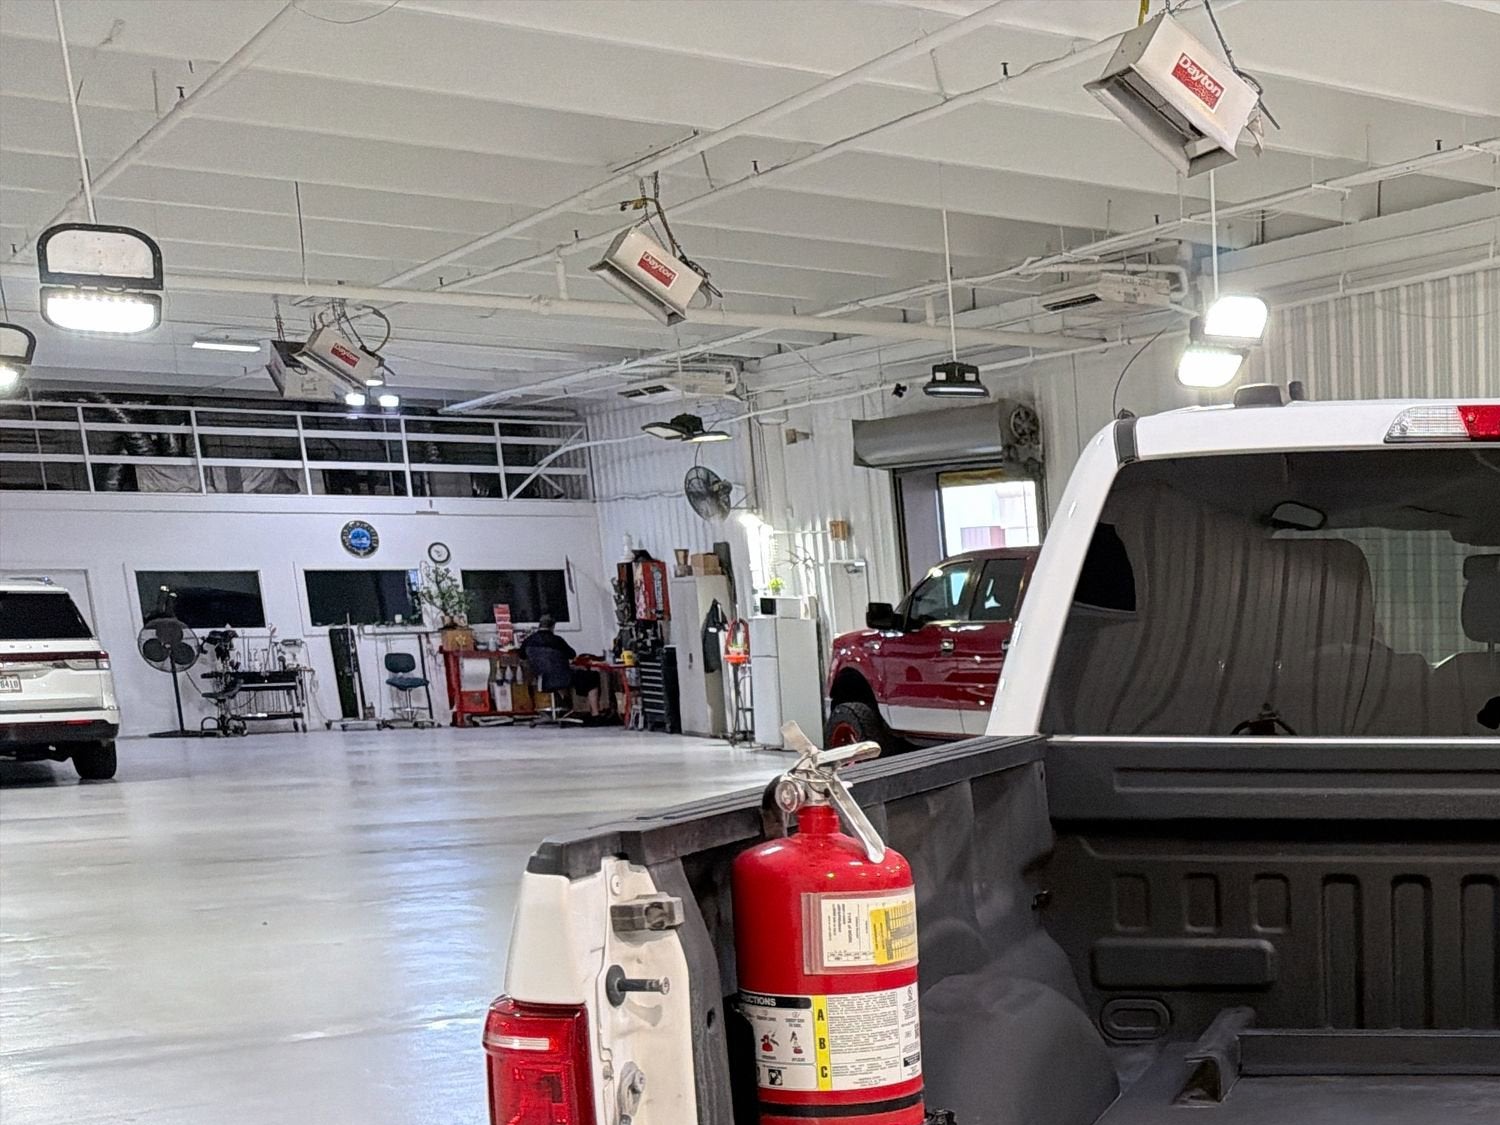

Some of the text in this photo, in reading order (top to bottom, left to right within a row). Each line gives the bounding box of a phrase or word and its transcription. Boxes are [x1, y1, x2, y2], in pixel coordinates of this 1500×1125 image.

[1179, 55, 1221, 97] Dayton
[643, 253, 675, 280] Dayton
[817, 1008, 825, 1021] A
[818, 1037, 826, 1050] B
[820, 1065, 828, 1078] C
